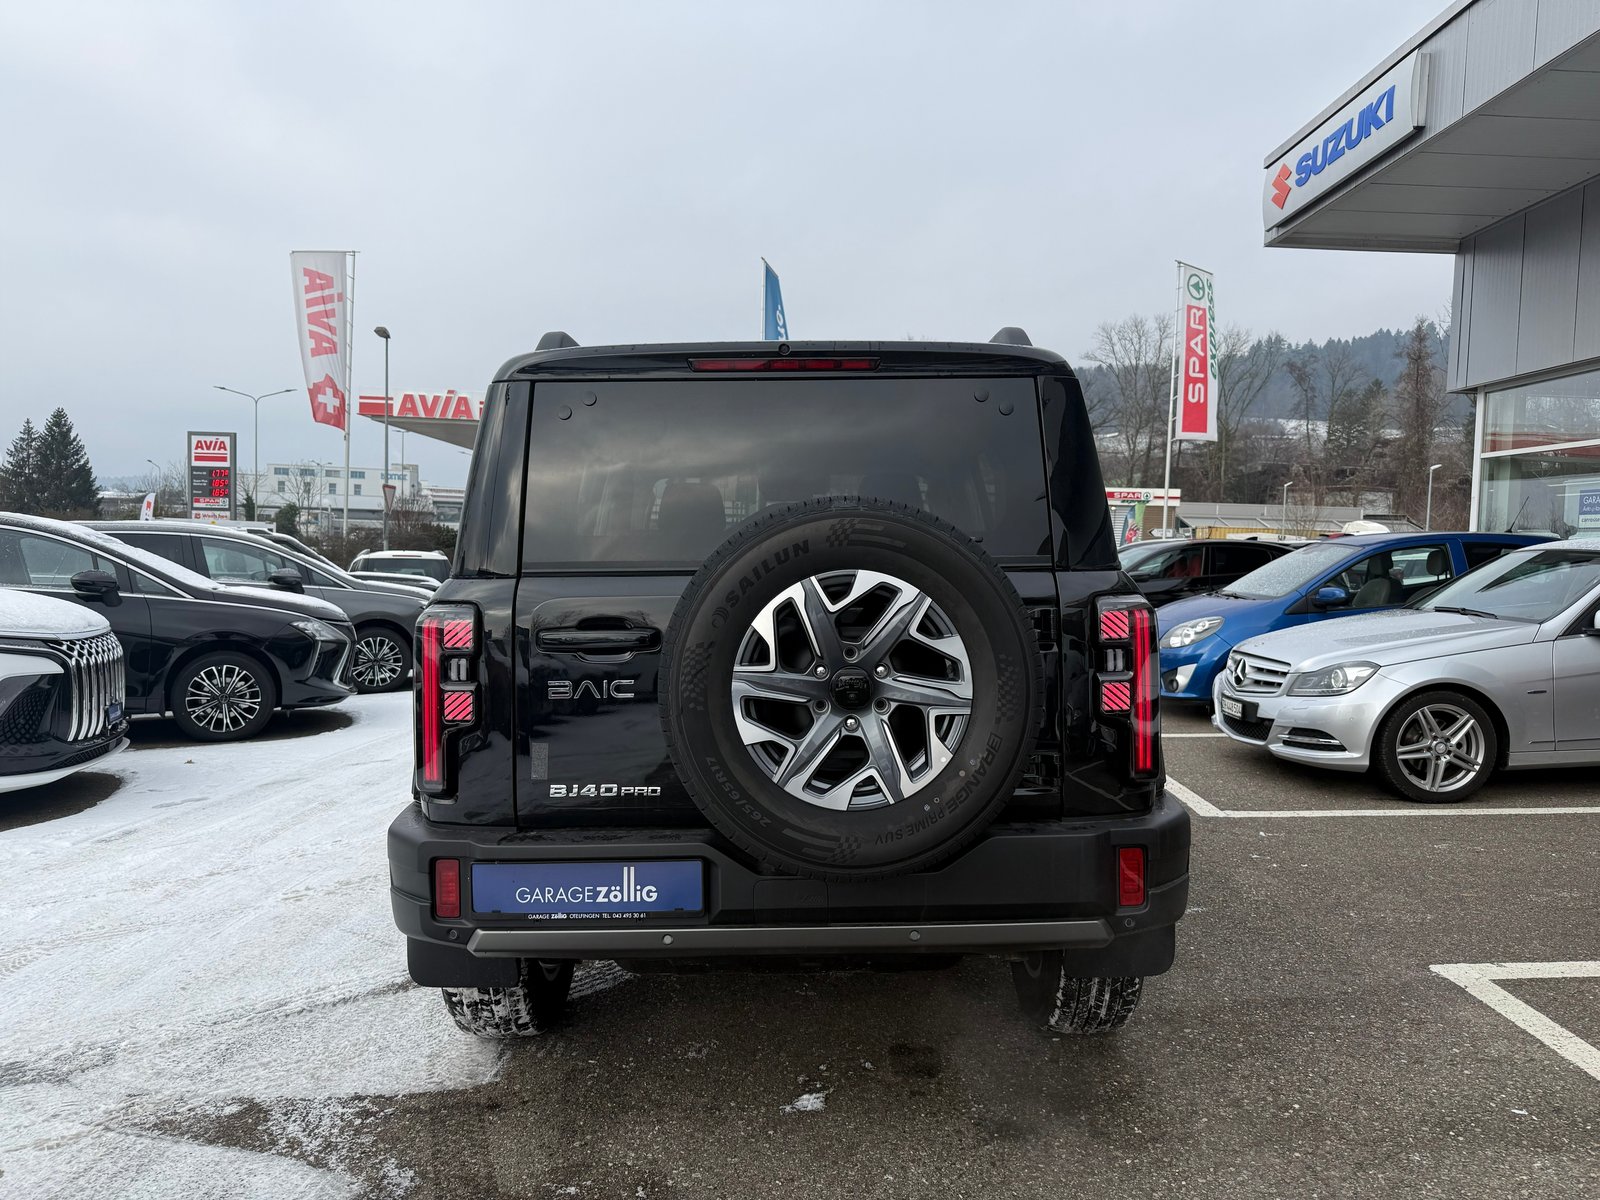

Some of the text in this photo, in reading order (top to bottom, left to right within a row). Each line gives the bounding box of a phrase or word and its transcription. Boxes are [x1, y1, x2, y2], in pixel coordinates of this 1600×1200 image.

[1295, 85, 1396, 188] SUZUKI
[1207, 278, 1217, 381] express
[1188, 308, 1205, 404] SPAR
[397, 389, 474, 420] AVIA
[194, 438, 228, 451] AVIA
[725, 538, 811, 608] SAILUN
[547, 679, 635, 700] BAIC
[549, 783, 661, 798] BJ40 PRO
[905, 809, 947, 836] PRIME
[874, 828, 905, 846] SUV
[515, 886, 594, 903] GARAGE
